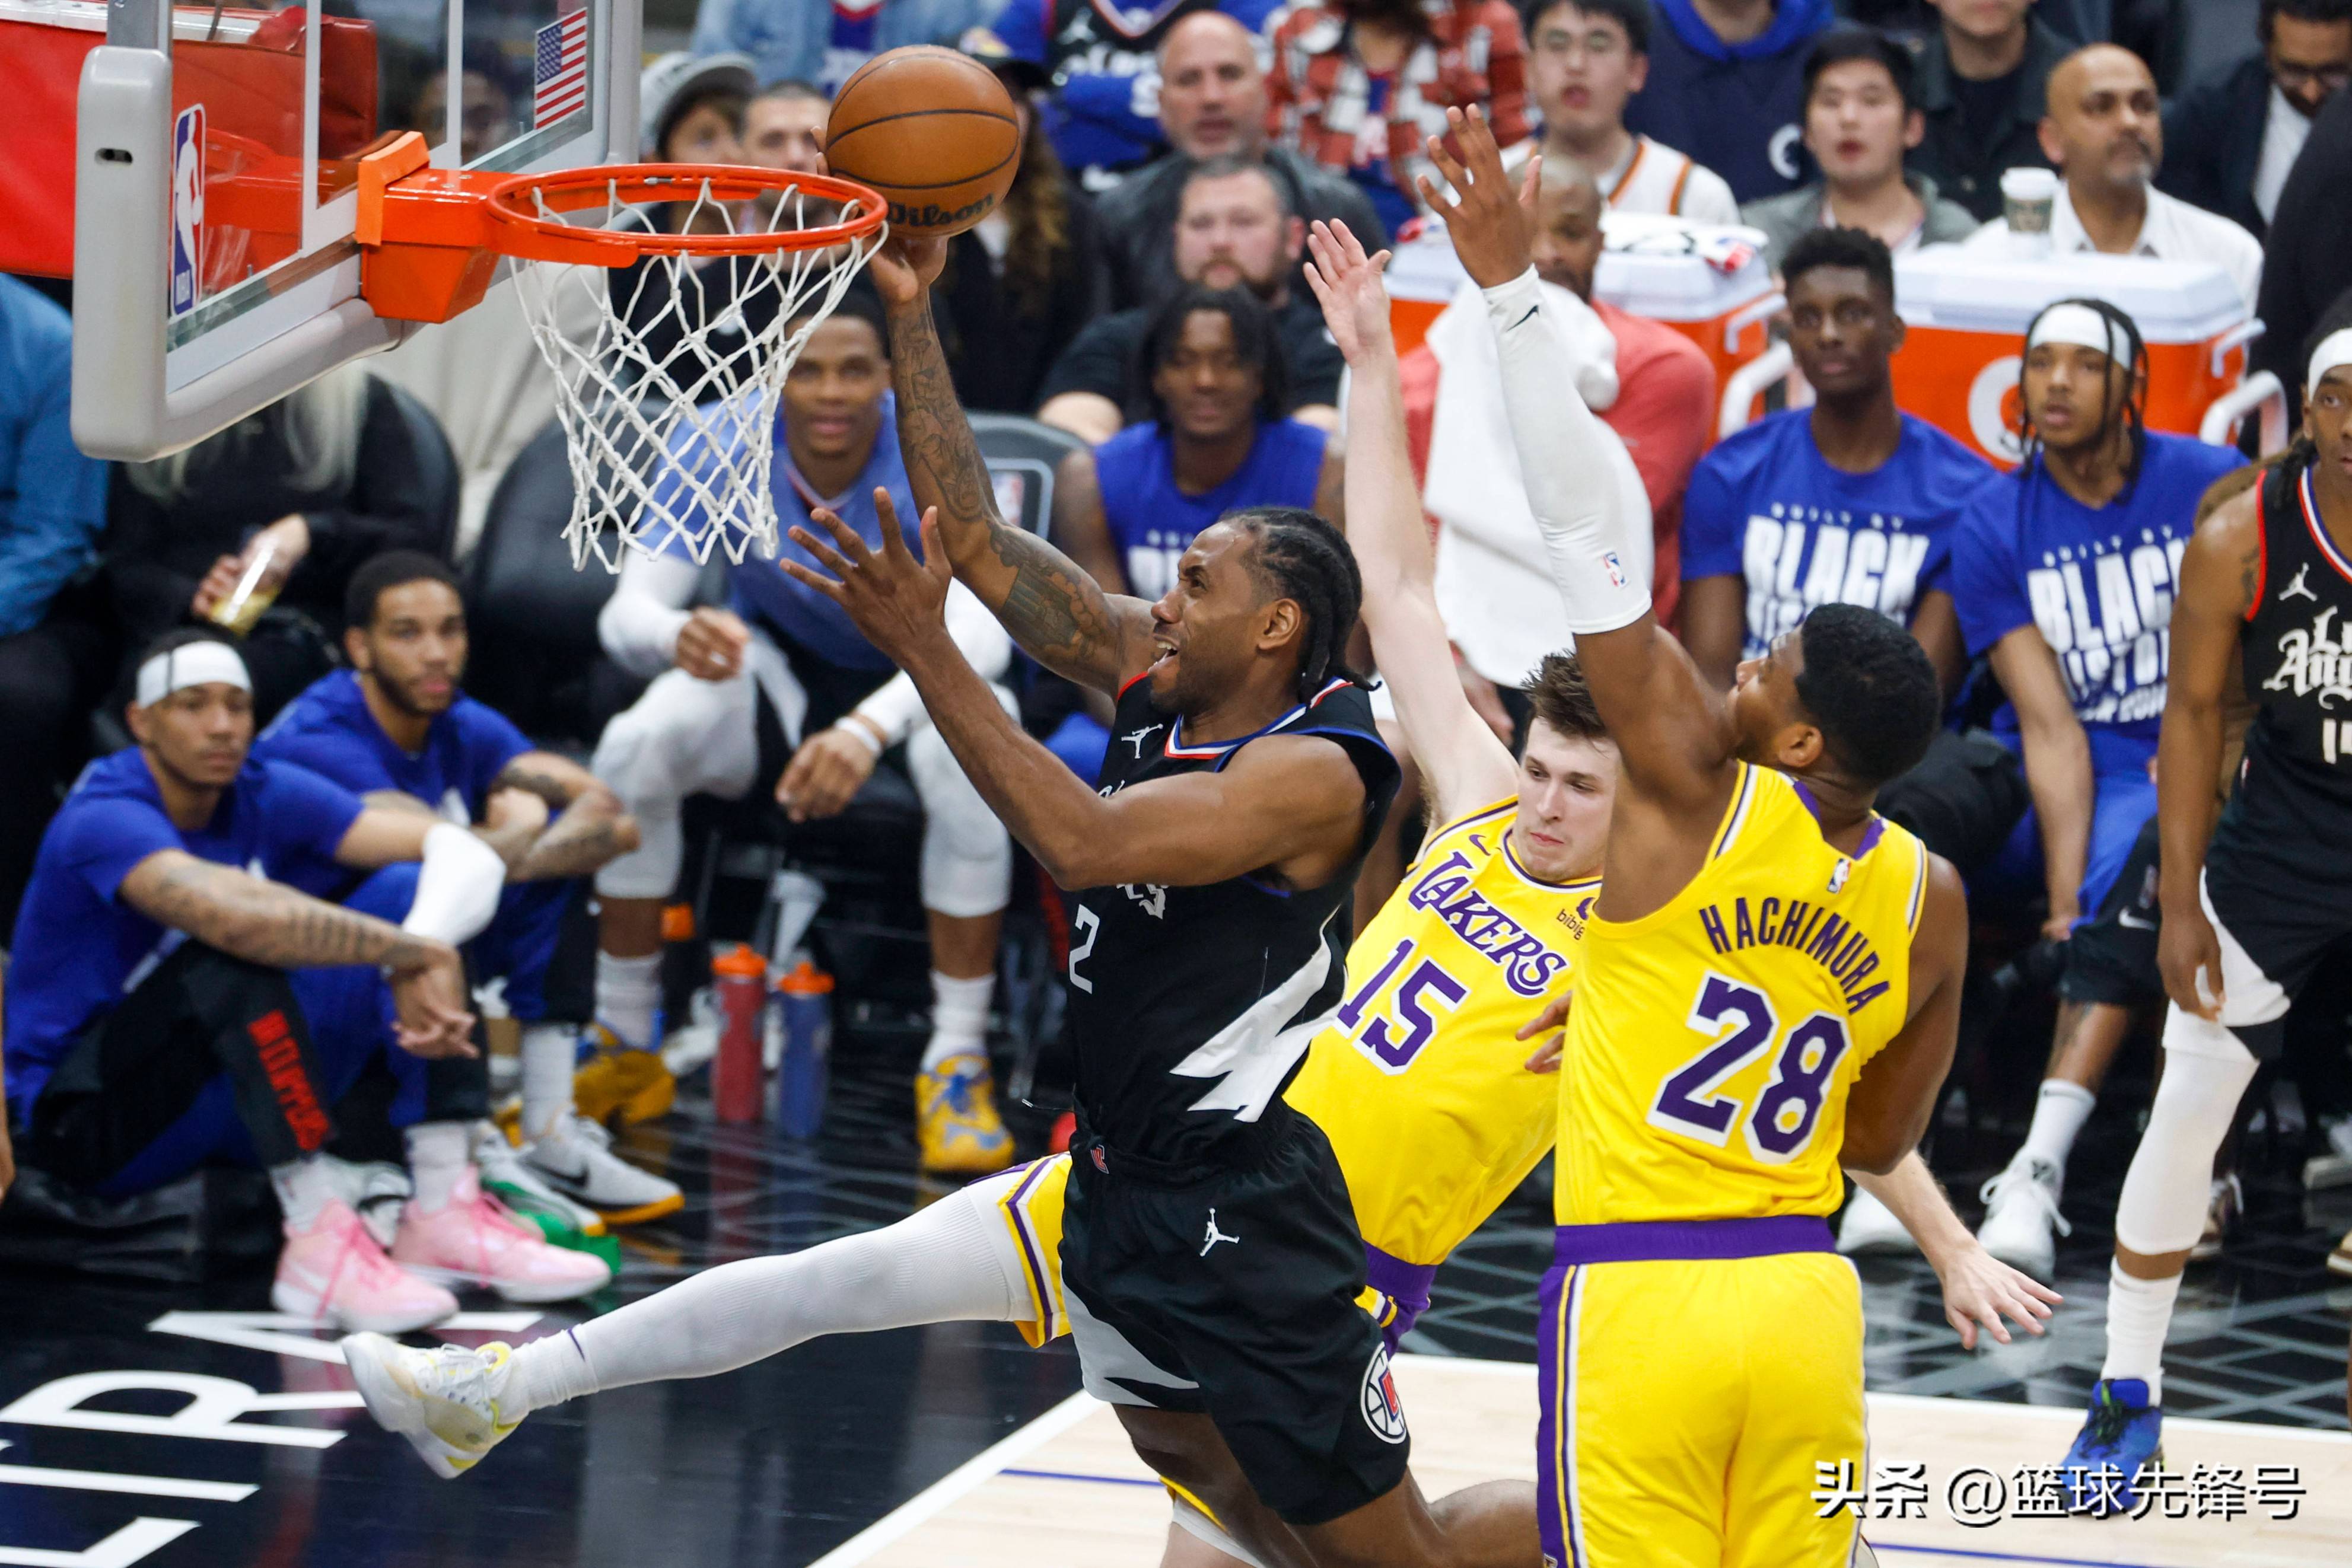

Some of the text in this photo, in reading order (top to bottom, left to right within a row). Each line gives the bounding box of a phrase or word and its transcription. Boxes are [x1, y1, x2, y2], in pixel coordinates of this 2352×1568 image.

[1742, 514, 1930, 620] BLACK
[1068, 903, 1100, 995] 2
[1406, 849, 1570, 998] LAKERS
[1698, 896, 1890, 1016] HACHIMURA
[1332, 935, 1472, 1076] 15
[1644, 968, 1853, 1153] 28
